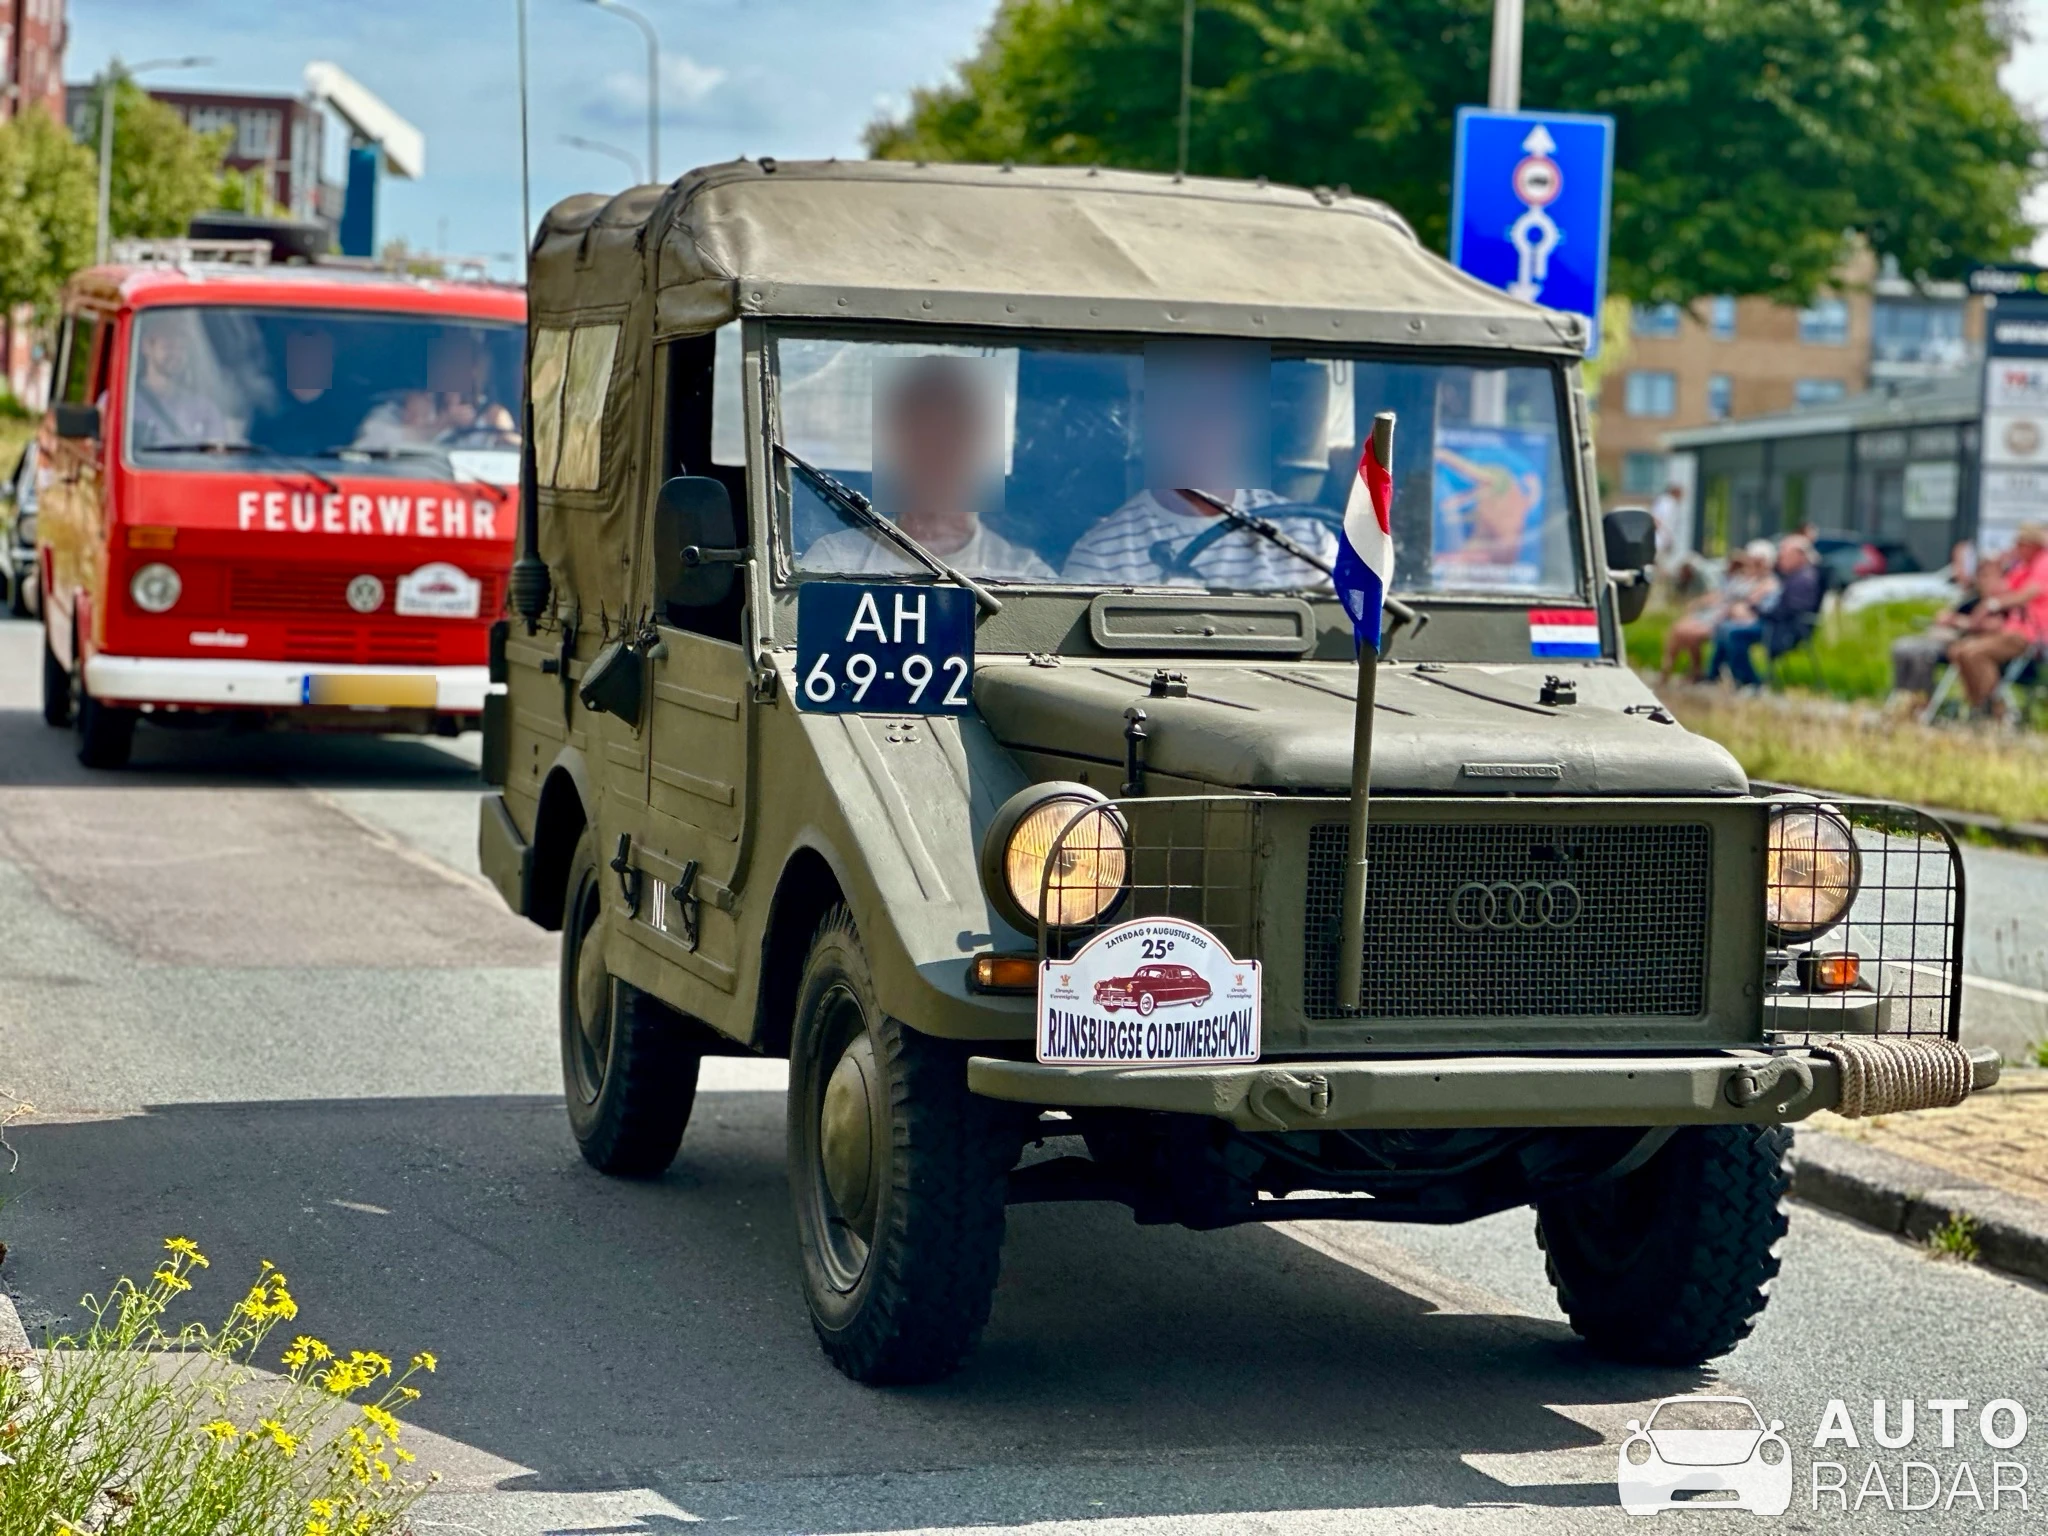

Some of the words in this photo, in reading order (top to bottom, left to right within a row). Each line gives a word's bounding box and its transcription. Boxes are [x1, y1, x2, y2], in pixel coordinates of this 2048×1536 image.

[238, 491, 496, 539] FEUERWEHR
[845, 592, 926, 644] AH
[804, 653, 968, 706] 69-92
[1467, 765, 1505, 776] AUTO
[1509, 765, 1560, 776] UNION
[1104, 927, 1145, 950] ZATERDAG
[1146, 927, 1151, 937] 9
[1152, 927, 1191, 941] AUGUSTUS
[1191, 934, 1208, 949] 2025
[1141, 938, 1175, 960] 25e
[1047, 1007, 1143, 1060] RIJNSBURGSE
[1147, 1007, 1253, 1060] OLDTIMERSHOW
